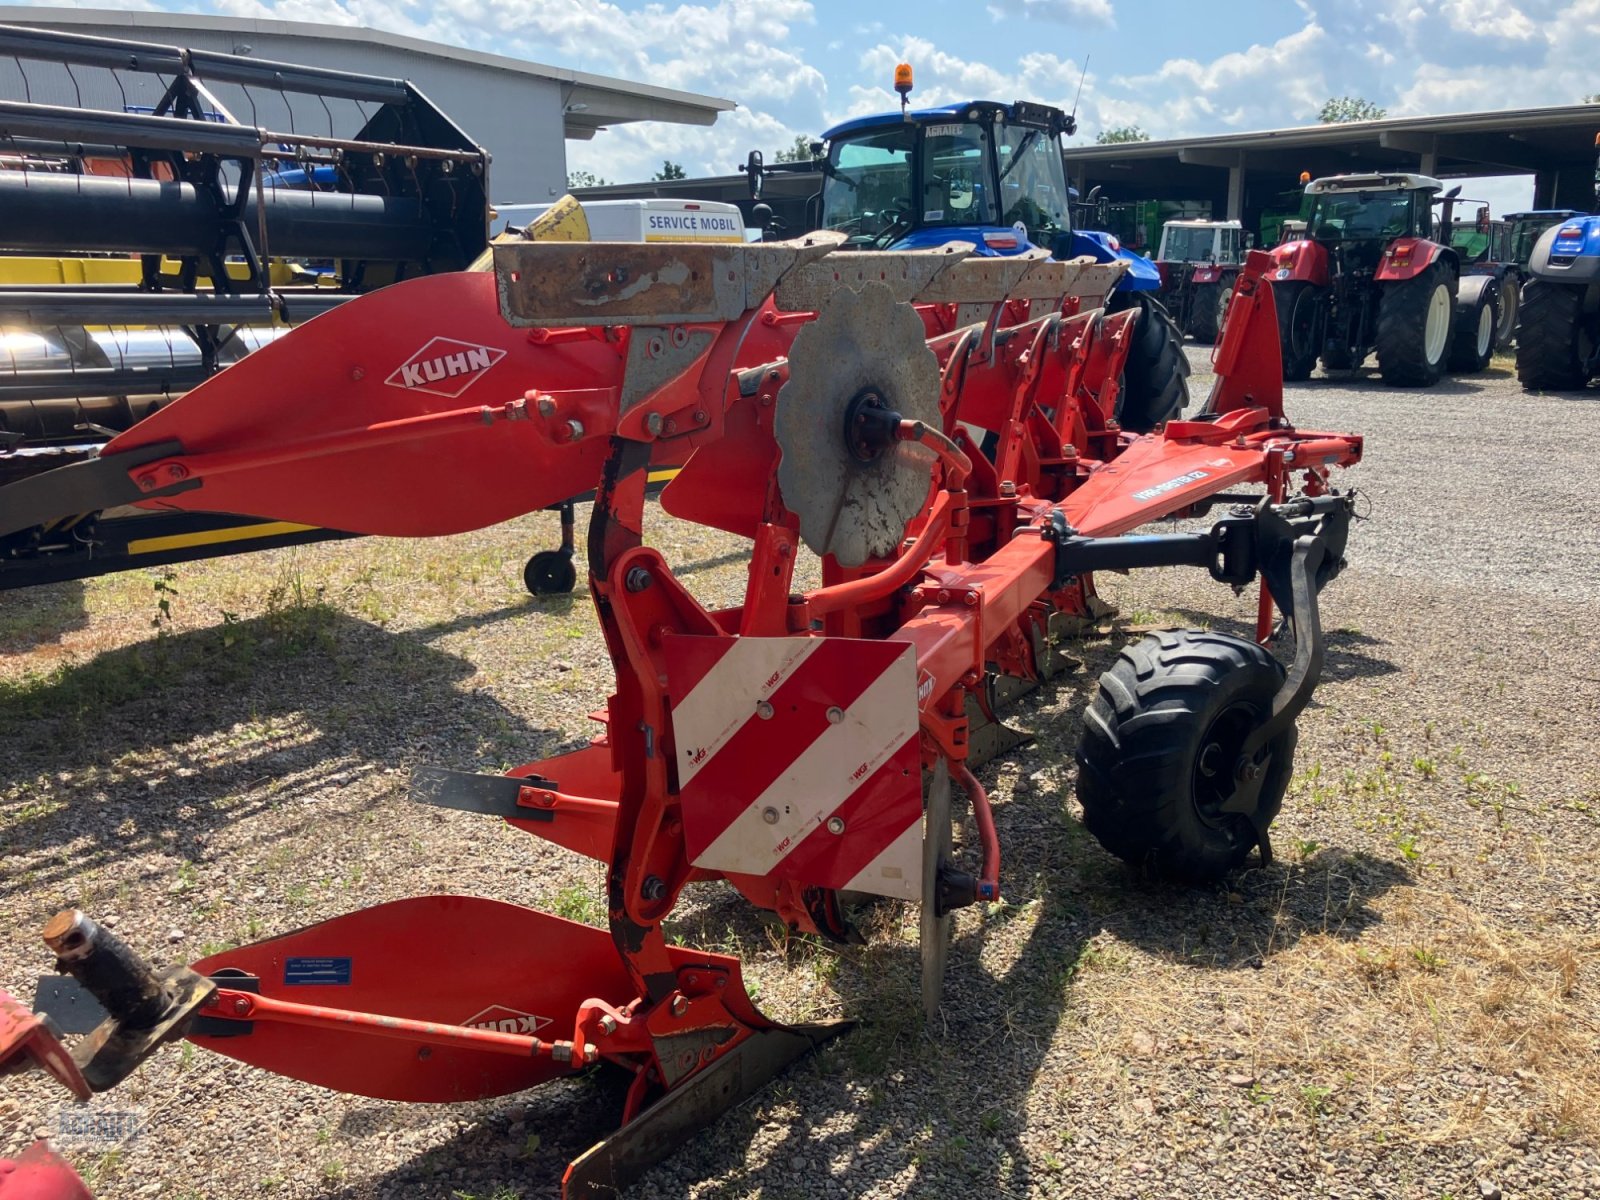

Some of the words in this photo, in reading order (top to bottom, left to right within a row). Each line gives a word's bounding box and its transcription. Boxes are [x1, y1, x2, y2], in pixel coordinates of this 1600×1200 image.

[925, 125, 963, 138] AGRATEC
[649, 215, 697, 230] SERVICE
[700, 217, 736, 231] MOBIL
[400, 346, 492, 389] KUHN
[766, 671, 781, 688] WGF
[918, 676, 934, 702] KUH
[692, 747, 707, 764] WGF
[853, 762, 868, 779] WGF
[776, 836, 791, 852] WGF
[468, 1015, 537, 1034] KUH
